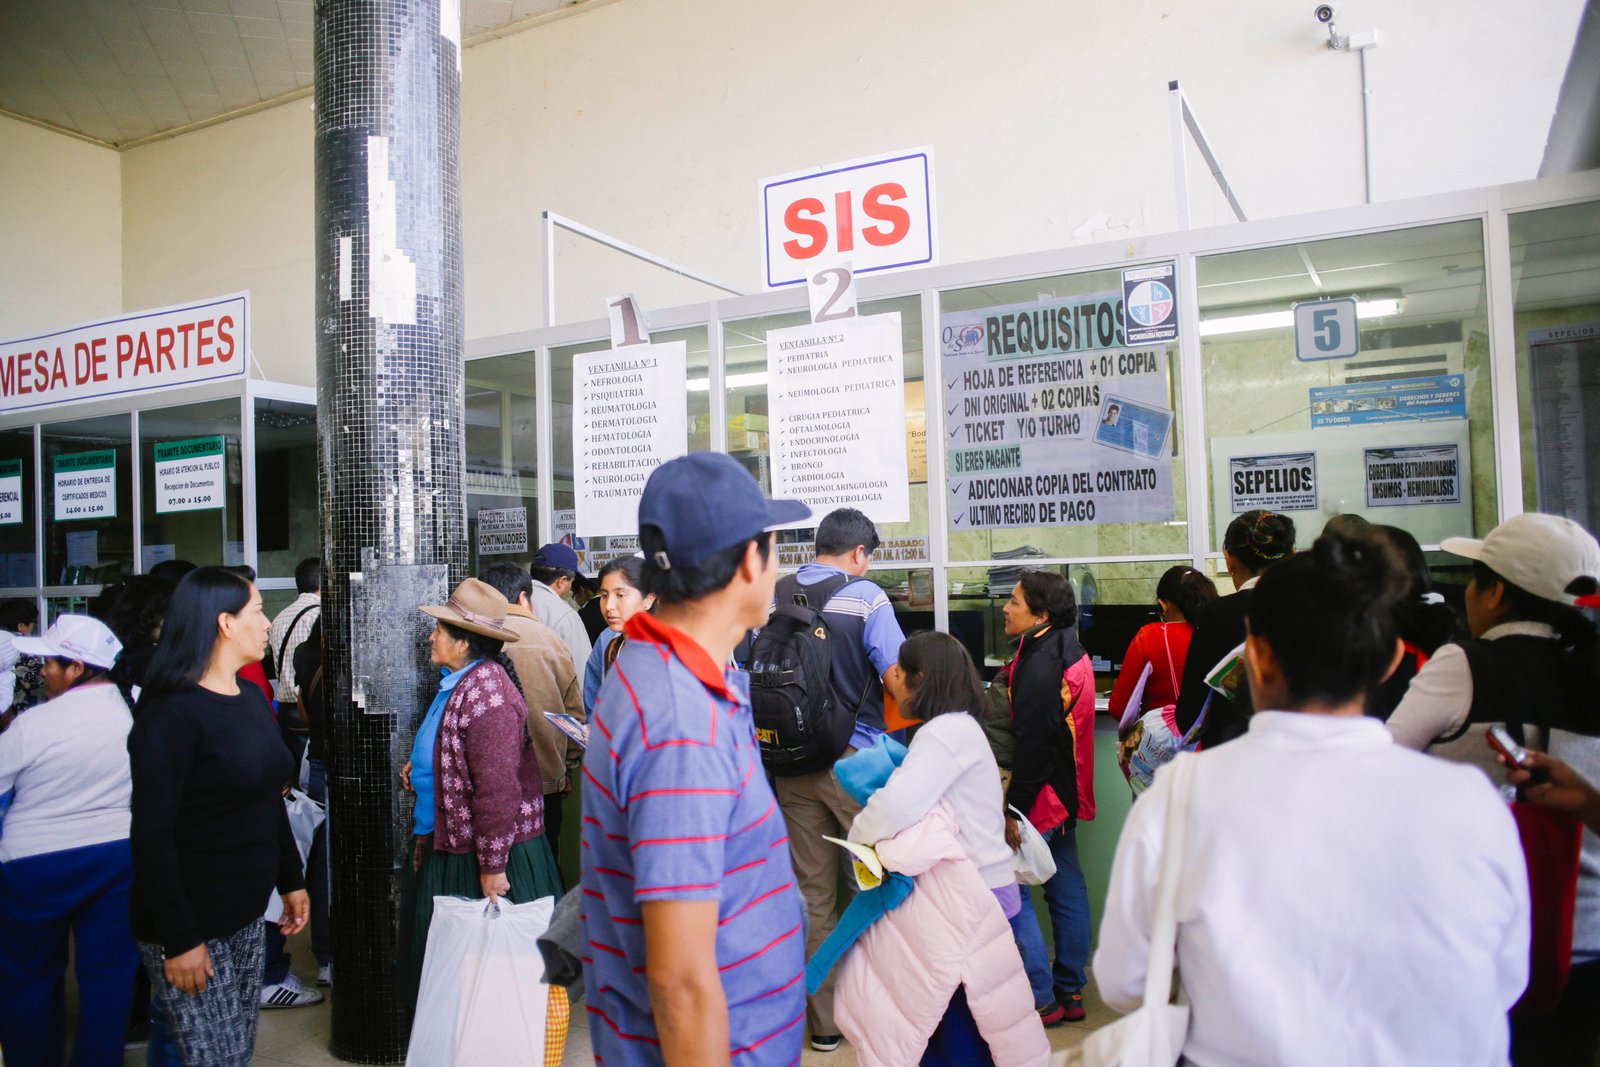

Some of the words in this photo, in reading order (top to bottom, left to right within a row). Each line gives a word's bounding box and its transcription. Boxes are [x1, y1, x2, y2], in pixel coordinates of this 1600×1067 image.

[783, 182, 911, 260] SIS
[812, 267, 856, 323] 2
[609, 297, 649, 347] 1
[1312, 308, 1341, 352] 5
[1548, 327, 1594, 338] SEPELIOS
[779, 336, 827, 350] VENTANILLA
[839, 333, 845, 342] 2
[0, 346, 68, 398] MESA
[74, 338, 109, 386] DE
[116, 315, 236, 379] PARTES
[786, 350, 829, 363] PEDIATRIA
[588, 360, 639, 374] VENTANILLA
[653, 358, 658, 367] 1
[787, 361, 838, 375] NEUROLOGIA
[841, 354, 894, 368] PEDIATRICA
[963, 368, 996, 391] HOJA
[999, 366, 1014, 387] DE
[1018, 358, 1084, 385] REFERENCIA
[1100, 354, 1114, 377] 01
[1118, 351, 1157, 376] COPIA
[590, 374, 643, 387] NEFROLOGIA
[590, 388, 644, 401] PSIQUIATRIA
[788, 386, 841, 398] NEUMOLOGIA
[844, 379, 897, 393] PEDIATRICA
[964, 396, 980, 417] DNI
[983, 391, 1030, 416] ORIGINAL
[1041, 388, 1055, 411] 02
[1057, 384, 1100, 409] COPIAS
[591, 401, 657, 415] REUMATOLOGIA
[788, 412, 821, 423] CIRUGIA
[822, 407, 871, 419] PEDIATRICA
[591, 415, 658, 429] DERMATOLOGIA
[789, 421, 851, 434] OFTALMOLOGIA
[964, 420, 1005, 443] TICKET
[1016, 416, 1036, 439] Y/O
[1039, 413, 1080, 436] TURNO
[591, 430, 652, 443] HEMATOLOGIA
[789, 433, 860, 446] ENDOCRINOLOGIA
[157, 446, 180, 458] TRAMITE
[180, 441, 222, 456] DOCUMENTARIO
[591, 444, 652, 457] ODONTOLOGIA
[790, 446, 848, 458] INFECTOLOGIA
[591, 457, 662, 471] REHABILITACION
[791, 461, 823, 471] BRONCO
[955, 453, 963, 473] SI
[965, 451, 984, 471] ERES
[986, 447, 1021, 470] PAGANTE
[159, 467, 175, 476] HORARIO
[175, 466, 180, 474] DE
[181, 464, 199, 474] ATENCION
[1368, 462, 1405, 480] COBERTURAS
[1404, 459, 1457, 479] EXTRAORDINARIAS
[58, 478, 77, 488] HORARIO
[77, 477, 84, 486] DE
[84, 476, 104, 485] ENTREGA
[104, 475, 111, 483] DE
[592, 473, 646, 485] NEUROLOGIA
[791, 471, 846, 483] CARDIOLOGIA
[1233, 466, 1313, 496] SEPELIOS
[164, 483, 184, 491] Recepcion
[184, 481, 189, 489] de
[792, 480, 888, 494] OTORRINOLARINGOLOGIA
[968, 476, 1033, 501] ADICIONAR
[1035, 473, 1070, 496] COPIA
[1072, 472, 1094, 494] DEL
[1096, 468, 1157, 493] CONTRATO
[1372, 481, 1403, 499] INSUMOS
[1407, 478, 1454, 498] HEMODIALISIS
[62, 491, 89, 501] CERTIFICADOS
[89, 490, 108, 499] MEDICOS
[168, 497, 186, 506] 07.00
[194, 495, 212, 503] 15.00
[798, 493, 883, 505] ASTROENTEROLOGIA
[66, 506, 82, 514] 14.00
[88, 505, 104, 513] 15.00
[969, 504, 1002, 526] ULTIMO
[1003, 502, 1036, 525] RECIBO
[1039, 502, 1056, 523] DE
[1060, 500, 1096, 522] PAGO
[480, 511, 505, 524] PACIENTES
[505, 510, 526, 523] NUEVOS
[480, 532, 526, 546] CONTINUADORES
[610, 537, 629, 549] HORARIO
[888, 539, 925, 549] SABADO
[778, 545, 799, 553] LUNES
